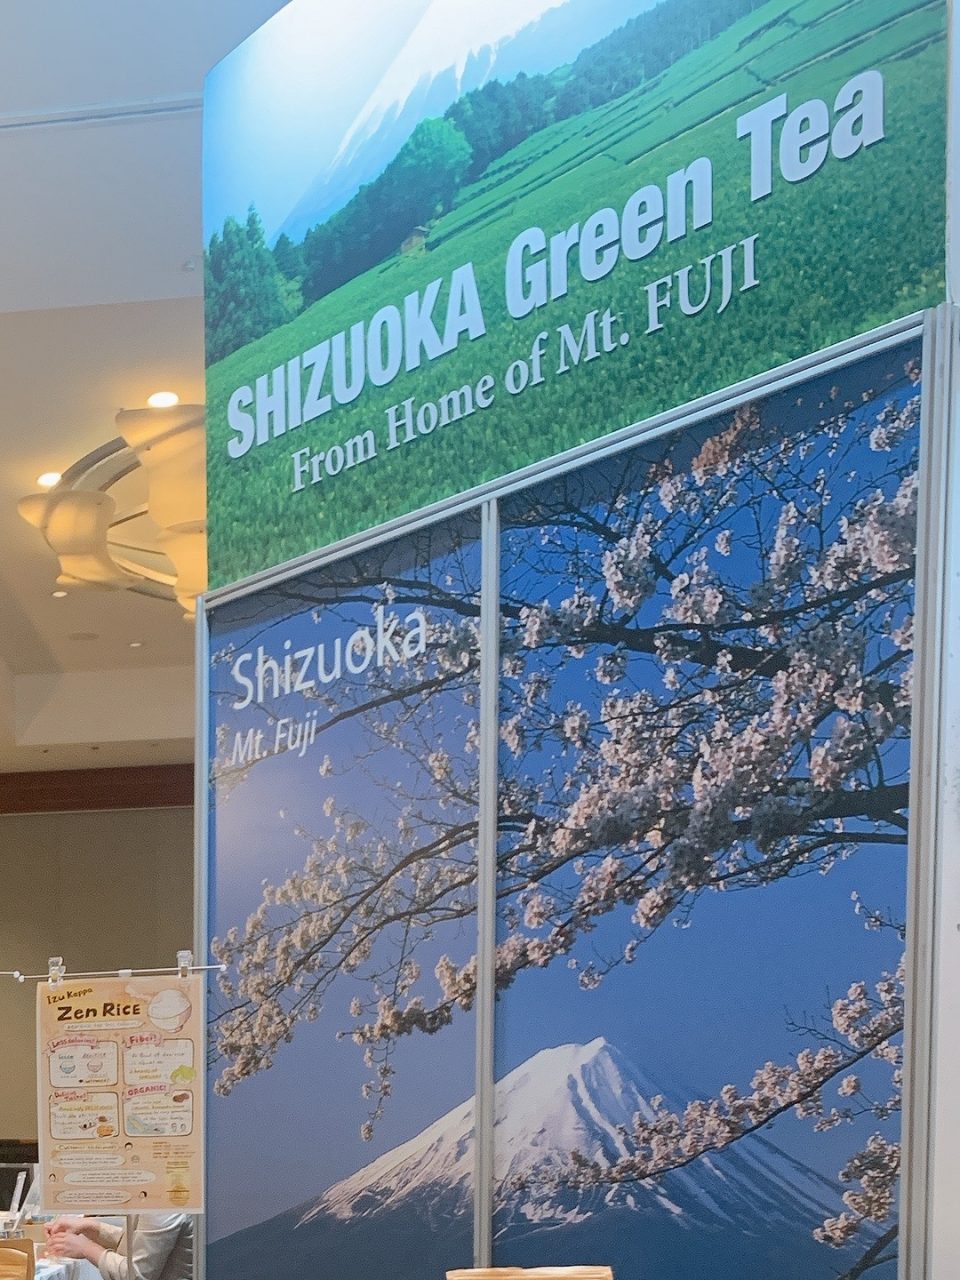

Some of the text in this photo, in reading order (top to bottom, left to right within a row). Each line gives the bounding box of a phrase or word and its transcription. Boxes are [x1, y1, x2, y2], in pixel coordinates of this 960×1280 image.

[226, 69, 886, 460] SHIZUOKA Green Tea
[291, 234, 761, 493] From Home of Mt. FUJI
[231, 605, 427, 711] Shizuoka
[231, 709, 319, 765] Mt. Fuji
[57, 1006, 98, 1022] Zen
